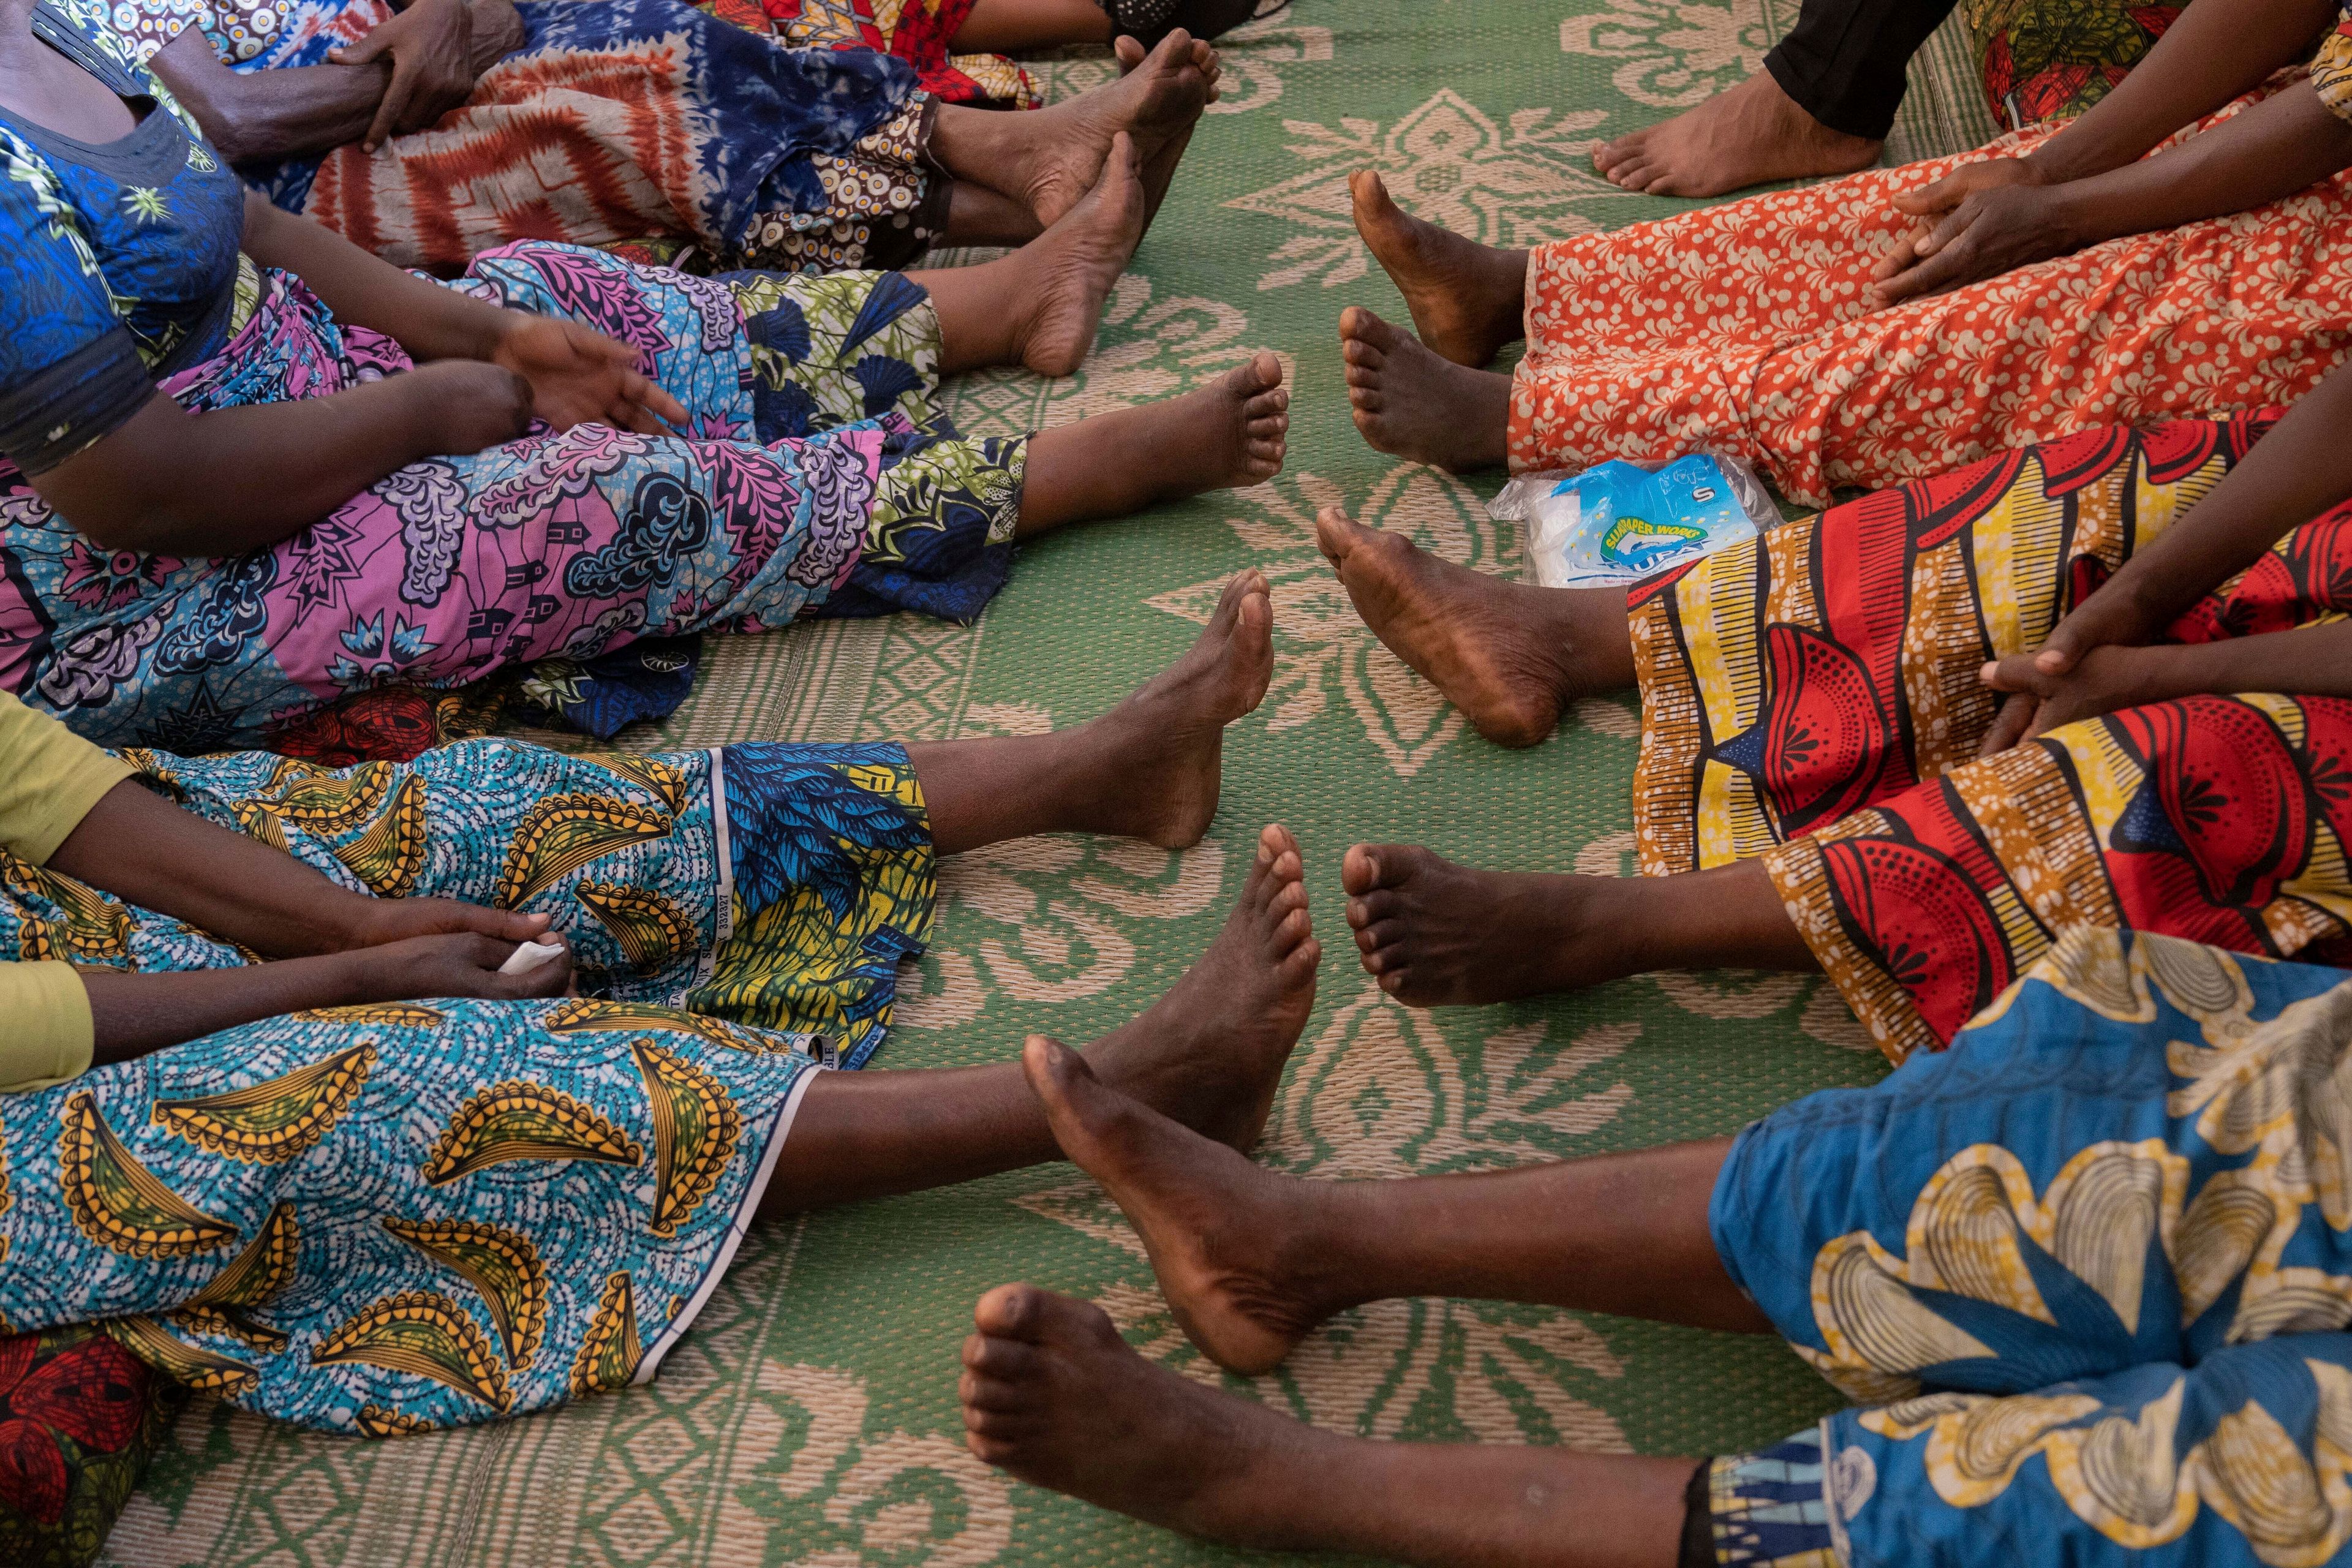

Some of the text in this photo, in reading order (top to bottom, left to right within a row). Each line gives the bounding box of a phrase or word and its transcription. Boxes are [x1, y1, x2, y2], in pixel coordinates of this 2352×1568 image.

[1692, 487, 1716, 503] S
[1657, 525, 1700, 538] WORKS
[718, 894, 729, 930] 332327
